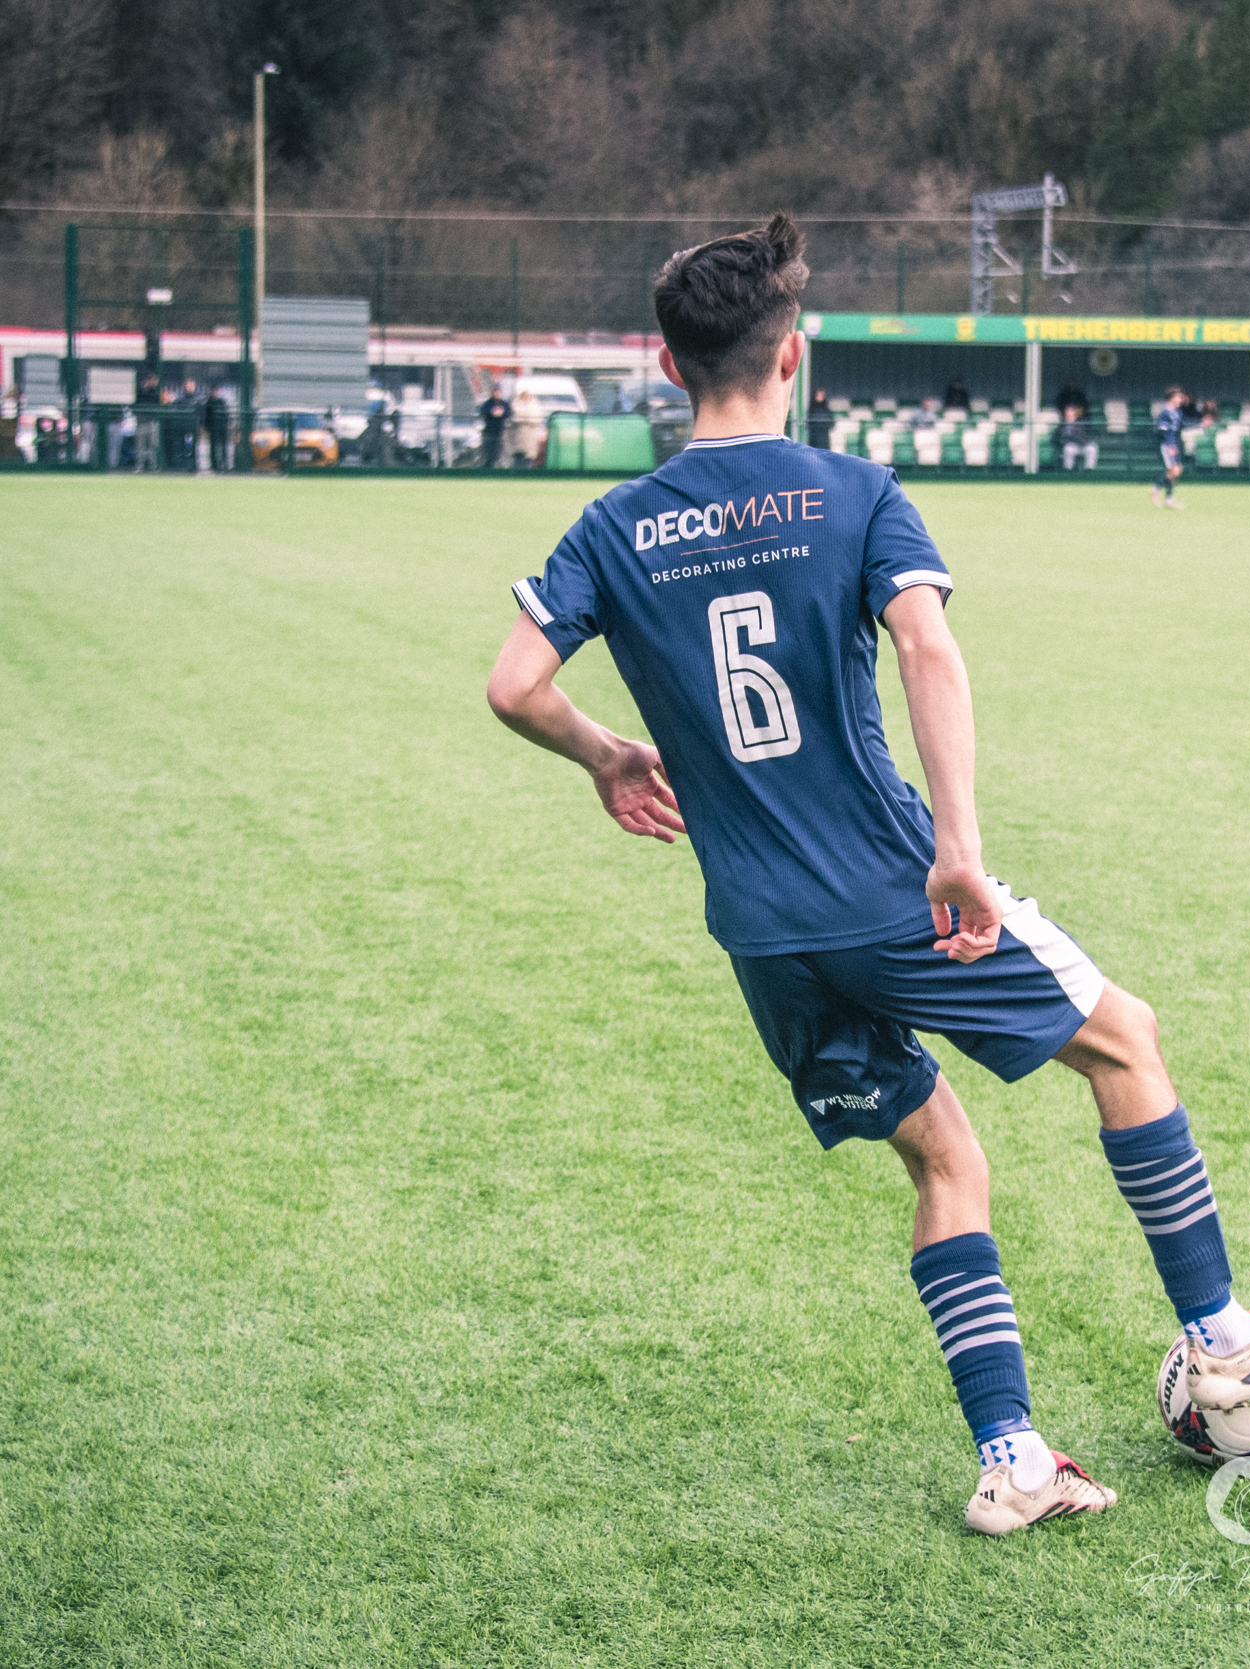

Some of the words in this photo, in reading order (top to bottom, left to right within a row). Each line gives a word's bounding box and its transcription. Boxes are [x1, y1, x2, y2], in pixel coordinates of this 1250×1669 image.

[635, 488, 824, 551] DECOMATE
[652, 556, 746, 584] DECORATING
[752, 546, 810, 566] CENTRE
[707, 590, 801, 763] 6
